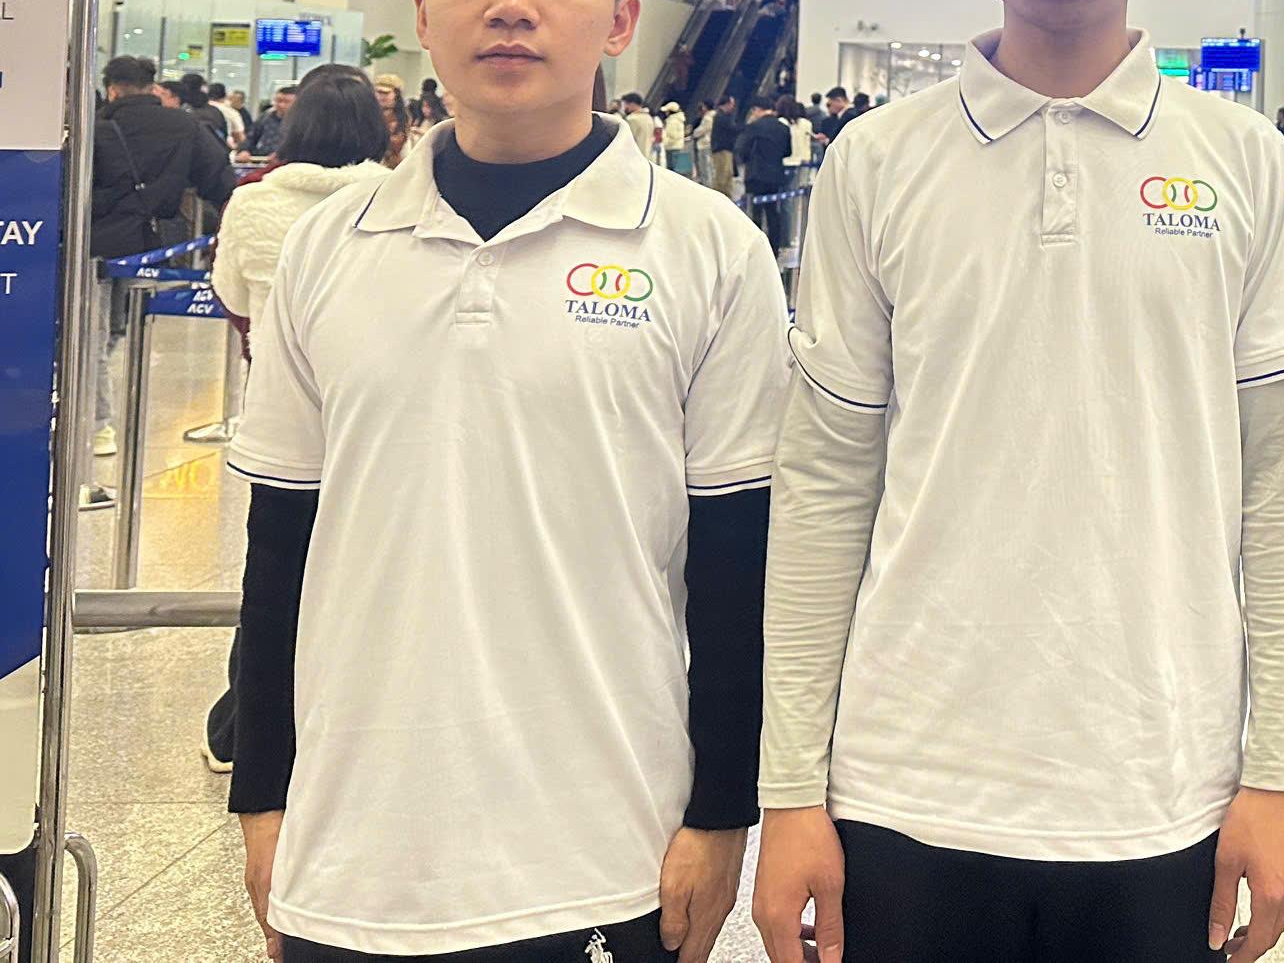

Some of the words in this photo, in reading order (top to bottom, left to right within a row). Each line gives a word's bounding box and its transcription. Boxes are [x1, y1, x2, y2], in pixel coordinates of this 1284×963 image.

[1143, 213, 1221, 232] TALOMA
[1155, 227, 1185, 236] Reliable
[1187, 229, 1213, 238] Partner
[136, 267, 160, 278] ACV
[187, 303, 215, 315] ACV
[565, 300, 651, 323] TALOMA
[575, 315, 608, 325] Reliable
[610, 318, 640, 329] Partner
